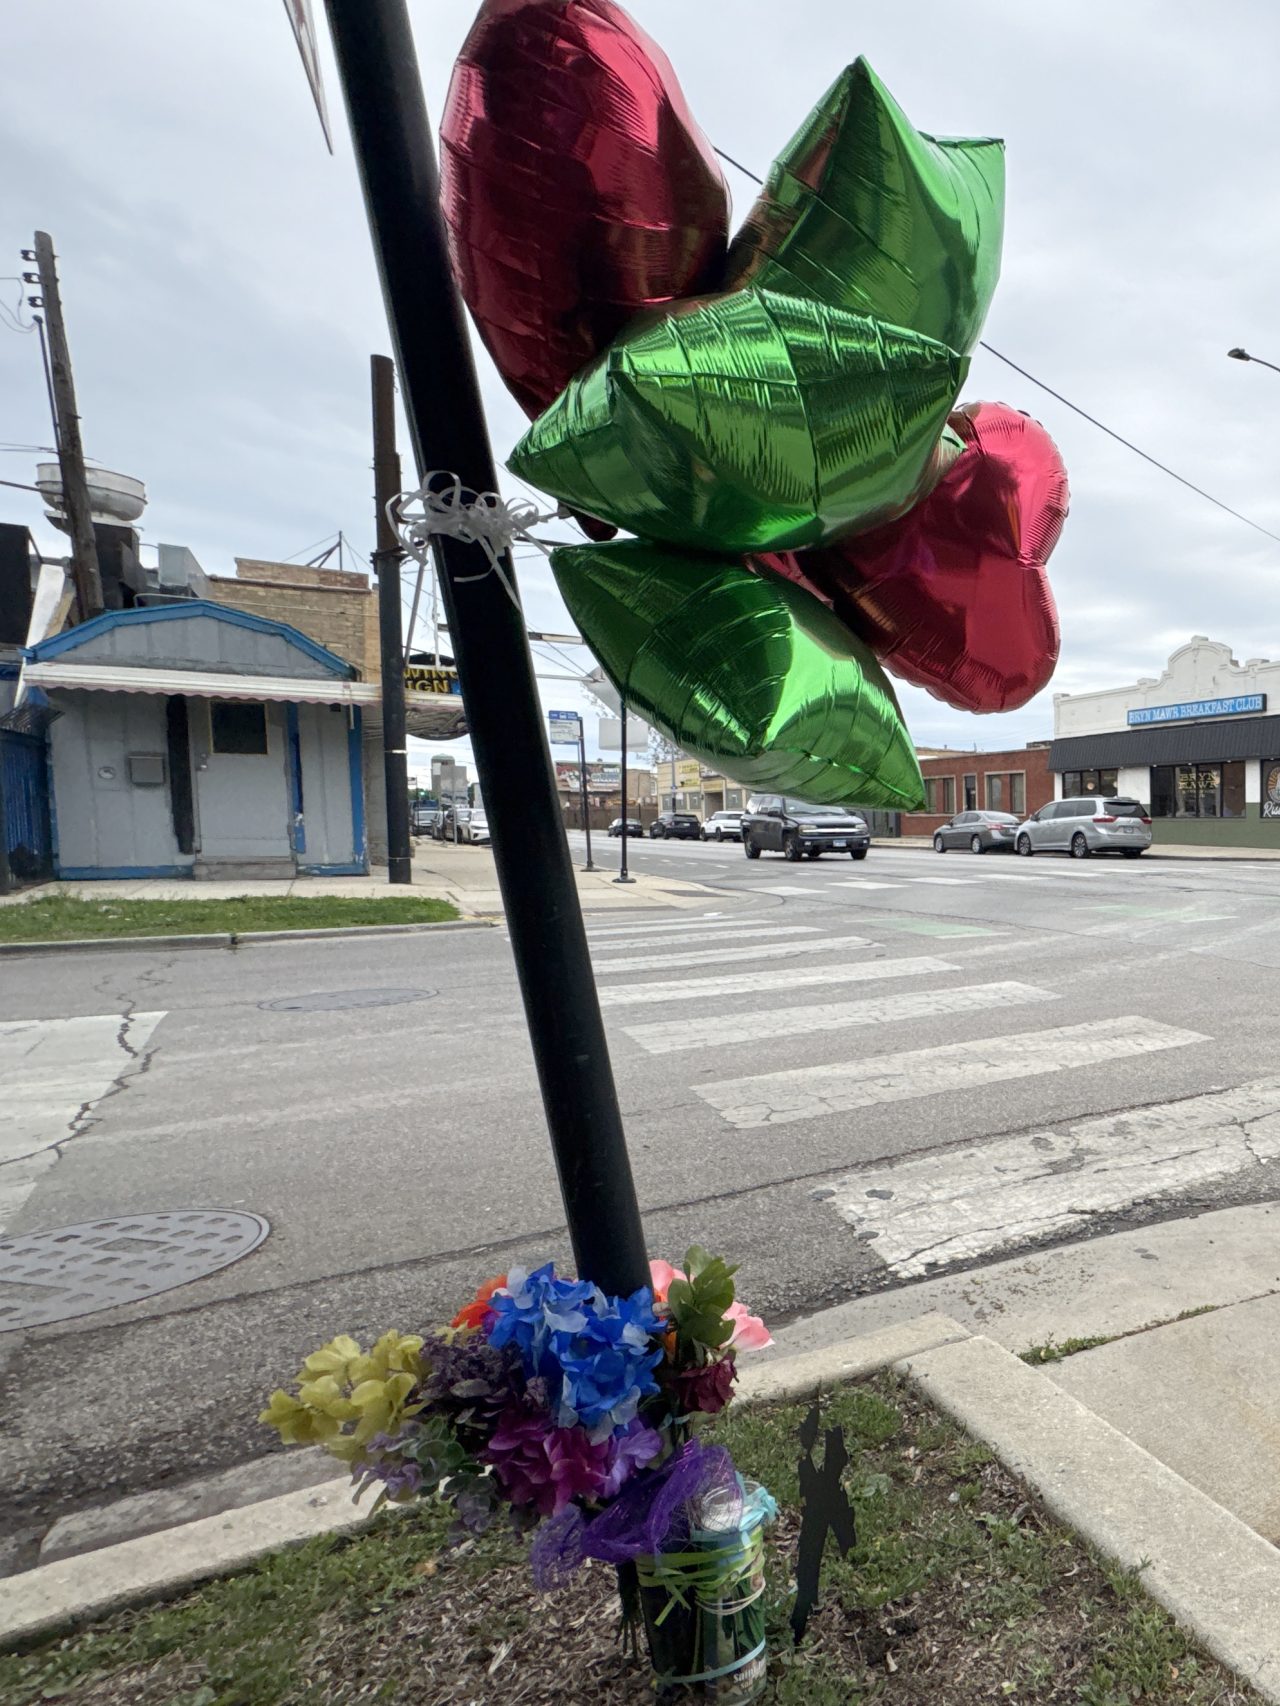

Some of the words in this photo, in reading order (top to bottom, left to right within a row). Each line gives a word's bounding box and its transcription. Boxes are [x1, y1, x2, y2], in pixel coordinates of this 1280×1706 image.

[1129, 709, 1150, 723] BRYN
[1152, 707, 1179, 721] MAWR
[1180, 700, 1235, 718] BREAKFAST
[1236, 696, 1263, 712] CLUB
